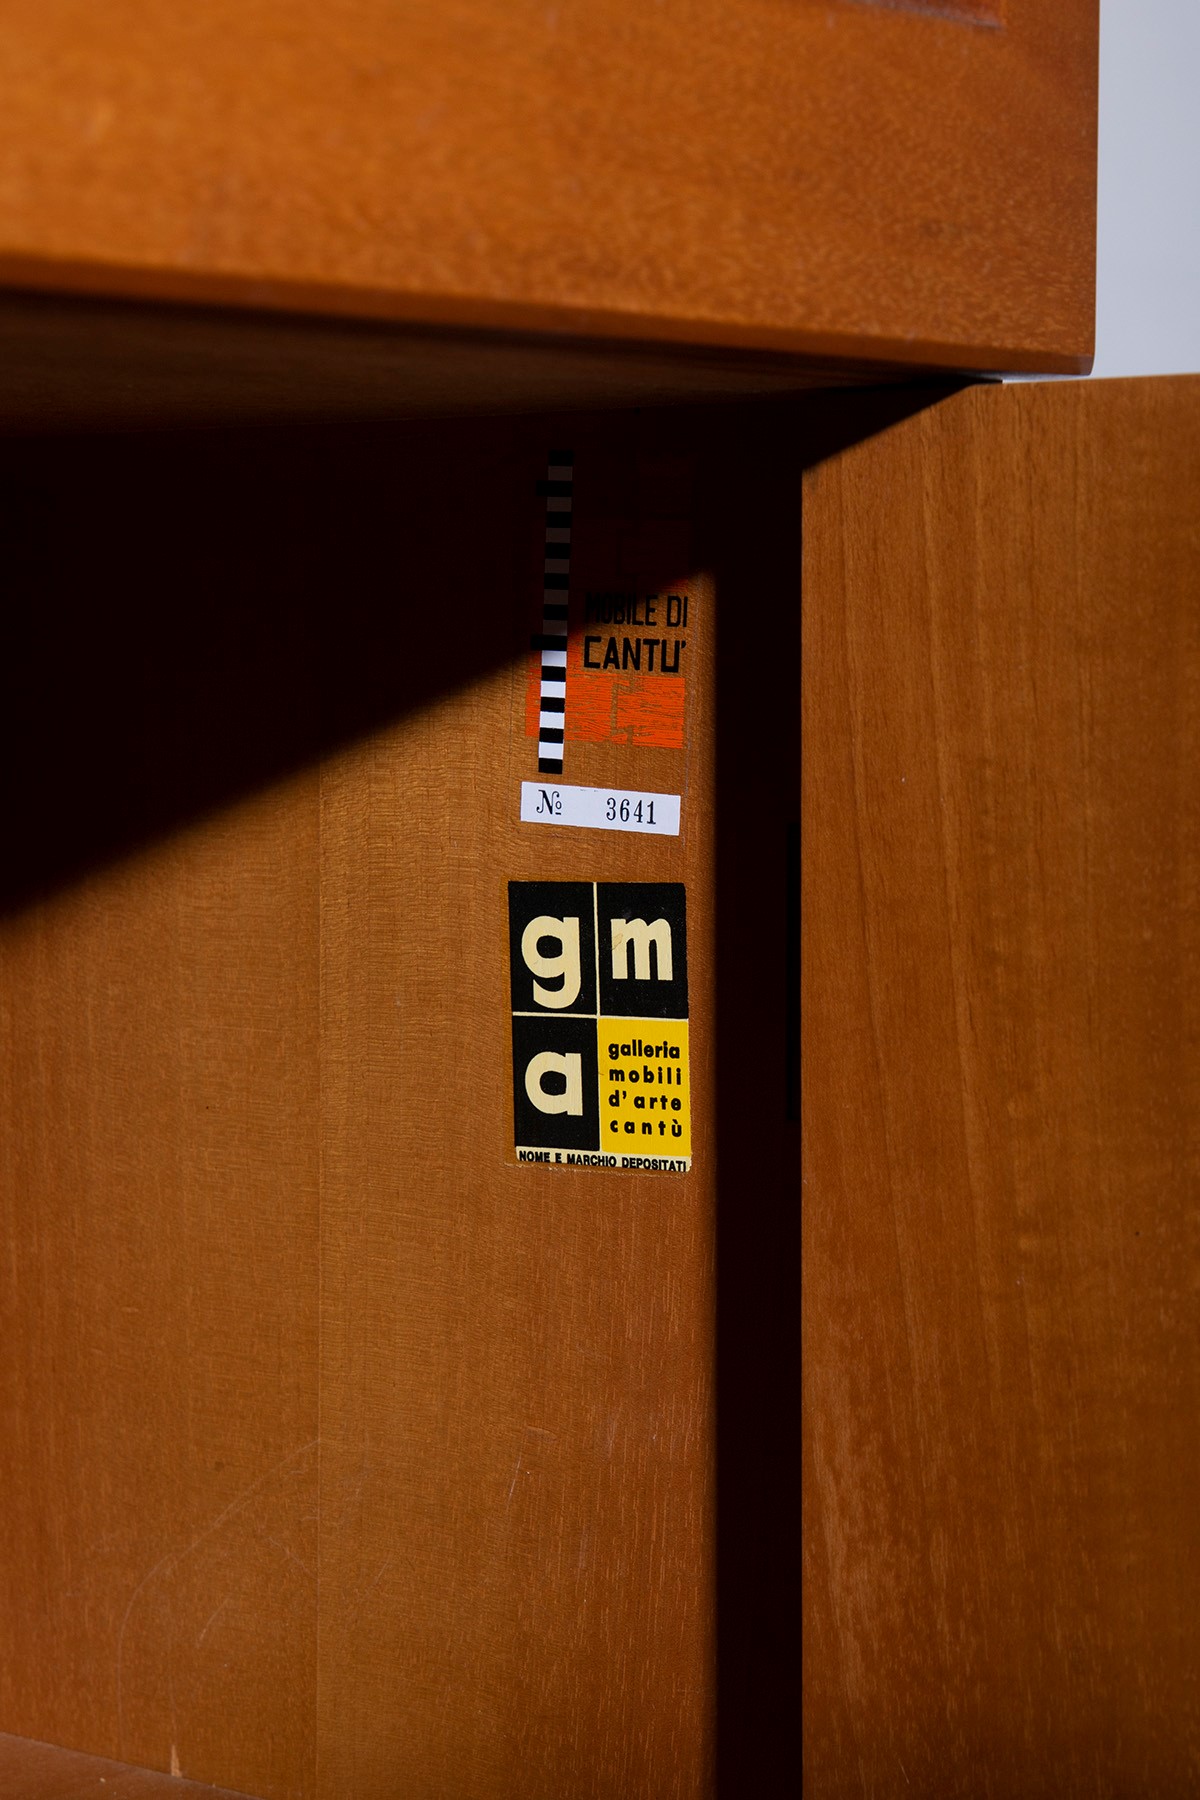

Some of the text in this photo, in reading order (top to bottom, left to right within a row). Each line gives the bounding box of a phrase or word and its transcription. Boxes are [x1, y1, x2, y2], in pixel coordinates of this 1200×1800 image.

[585, 592, 688, 628] MOBILE DI
[584, 635, 687, 673] CANTU'
[606, 797, 657, 825] 3641
[608, 1039, 680, 1060] galleria
[609, 1065, 682, 1086] mobili
[609, 1118, 683, 1138] cantù
[519, 1150, 687, 1173] NOME E MARCHIO DEPOSITATI
